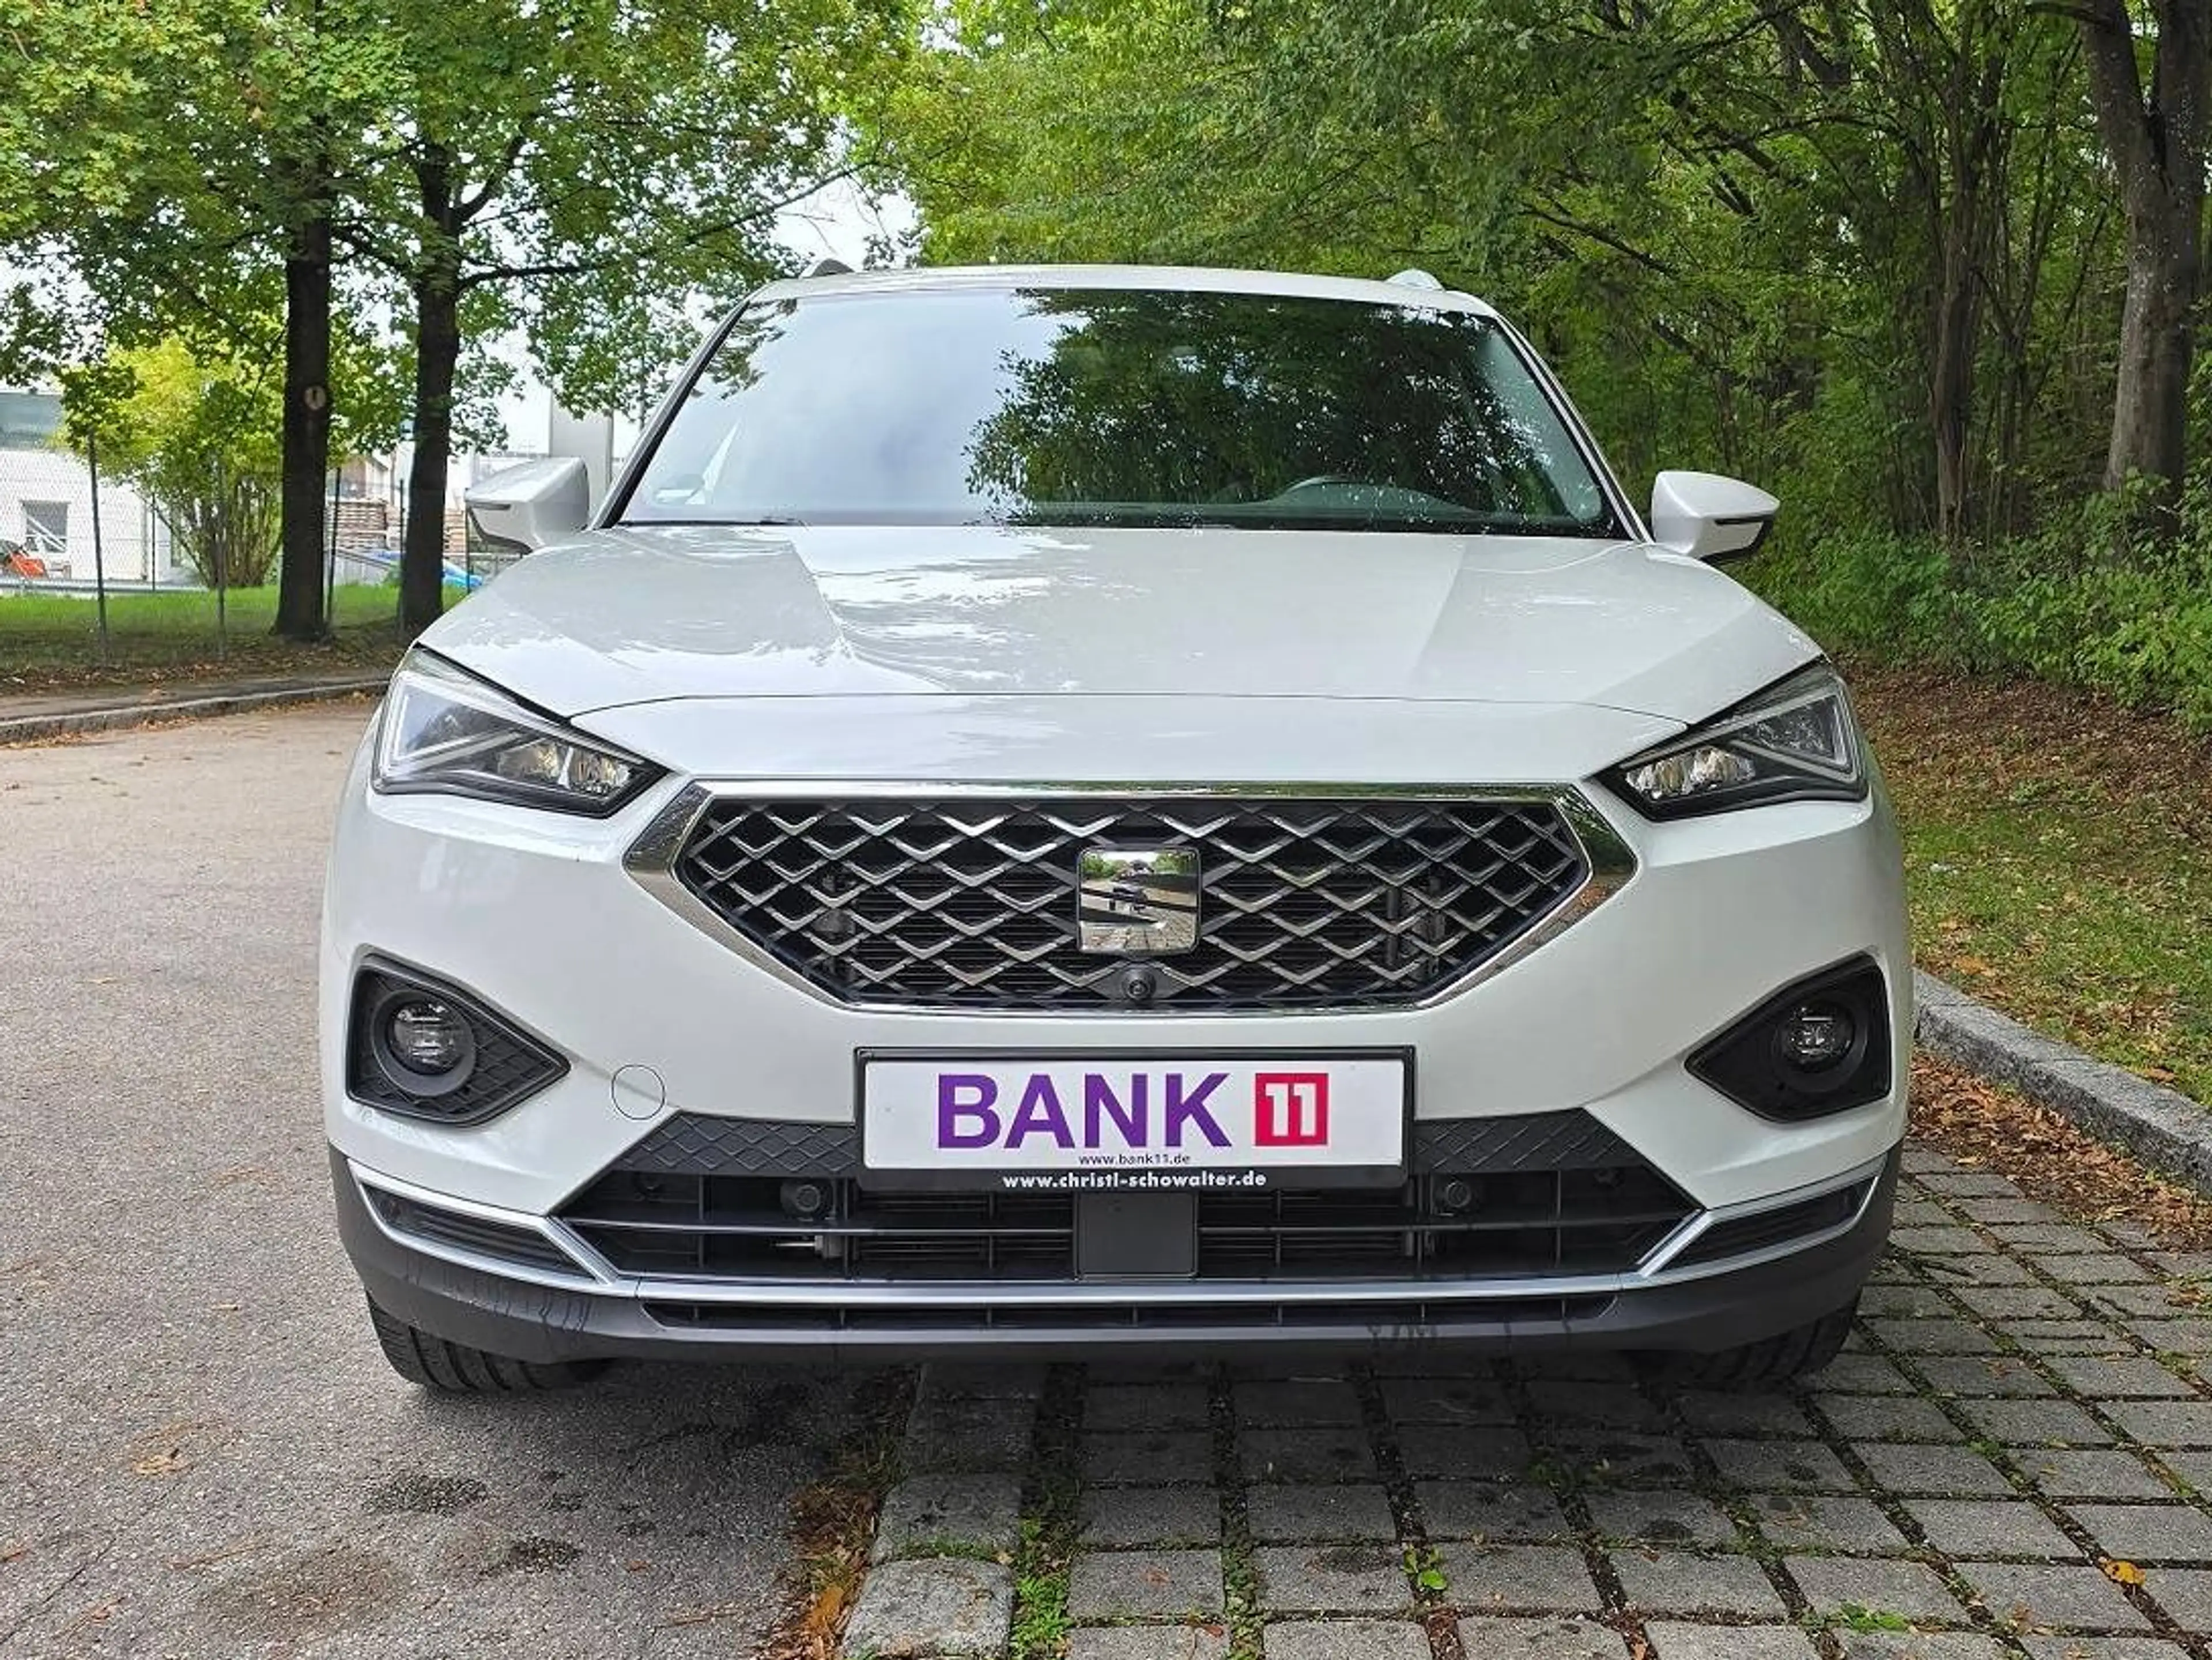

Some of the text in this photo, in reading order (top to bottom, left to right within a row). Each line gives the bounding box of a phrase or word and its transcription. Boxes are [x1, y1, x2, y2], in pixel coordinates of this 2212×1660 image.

[938, 1072, 1318, 1149] BANK 11
[1078, 1153, 1191, 1165] www.bank11.de
[1002, 1170, 1267, 1188] www.christl-schowalter.de
